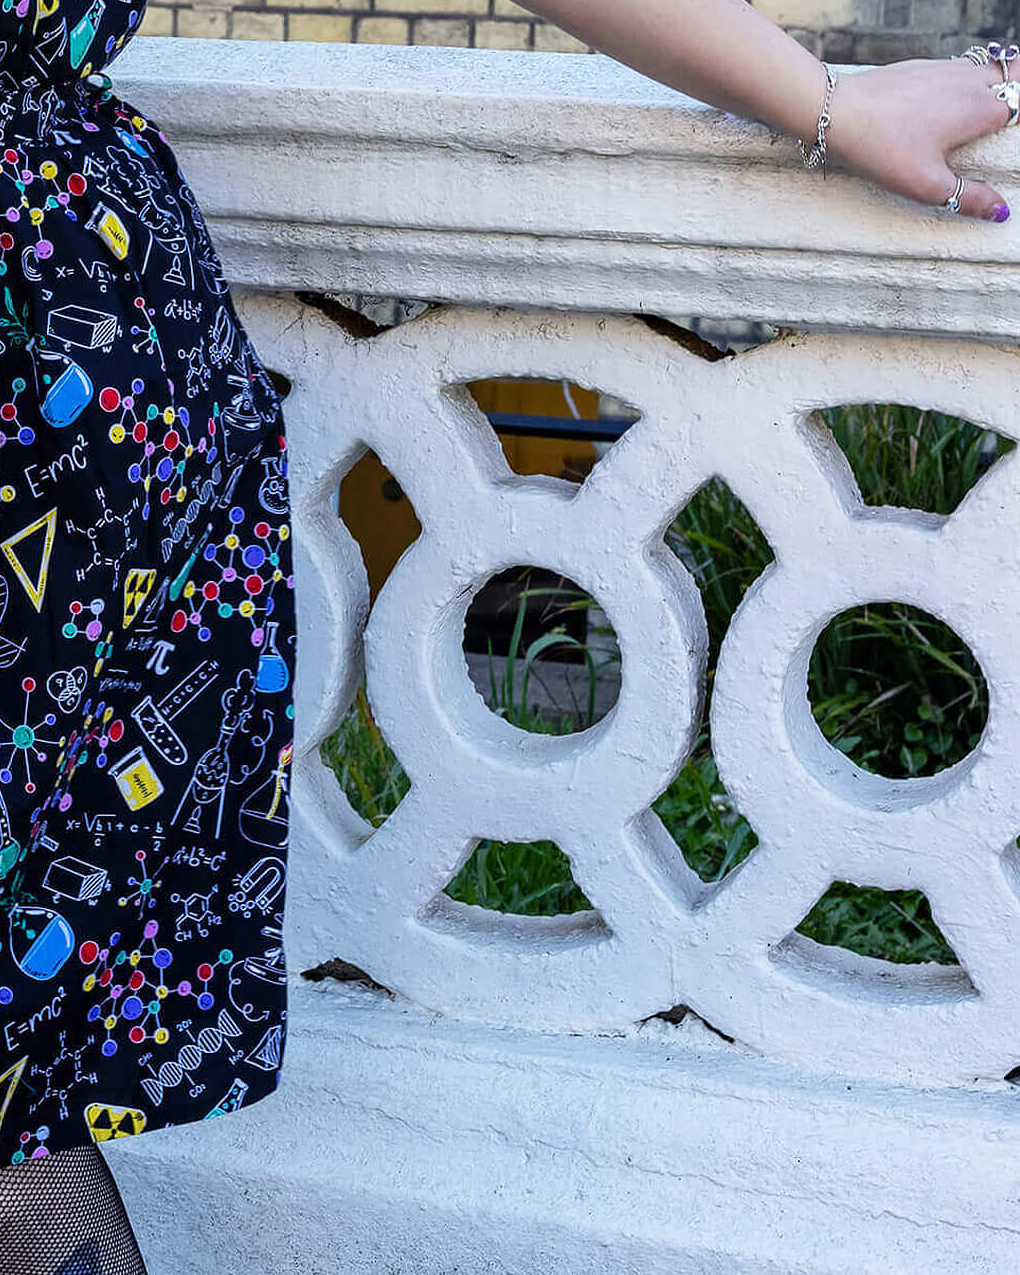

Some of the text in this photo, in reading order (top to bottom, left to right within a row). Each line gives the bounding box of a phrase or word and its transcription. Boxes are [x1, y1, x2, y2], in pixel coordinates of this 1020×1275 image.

[25, 434, 89, 499] E=mc²
[144, 640, 176, 676] π
[3, 986, 67, 1051] E=mc²
